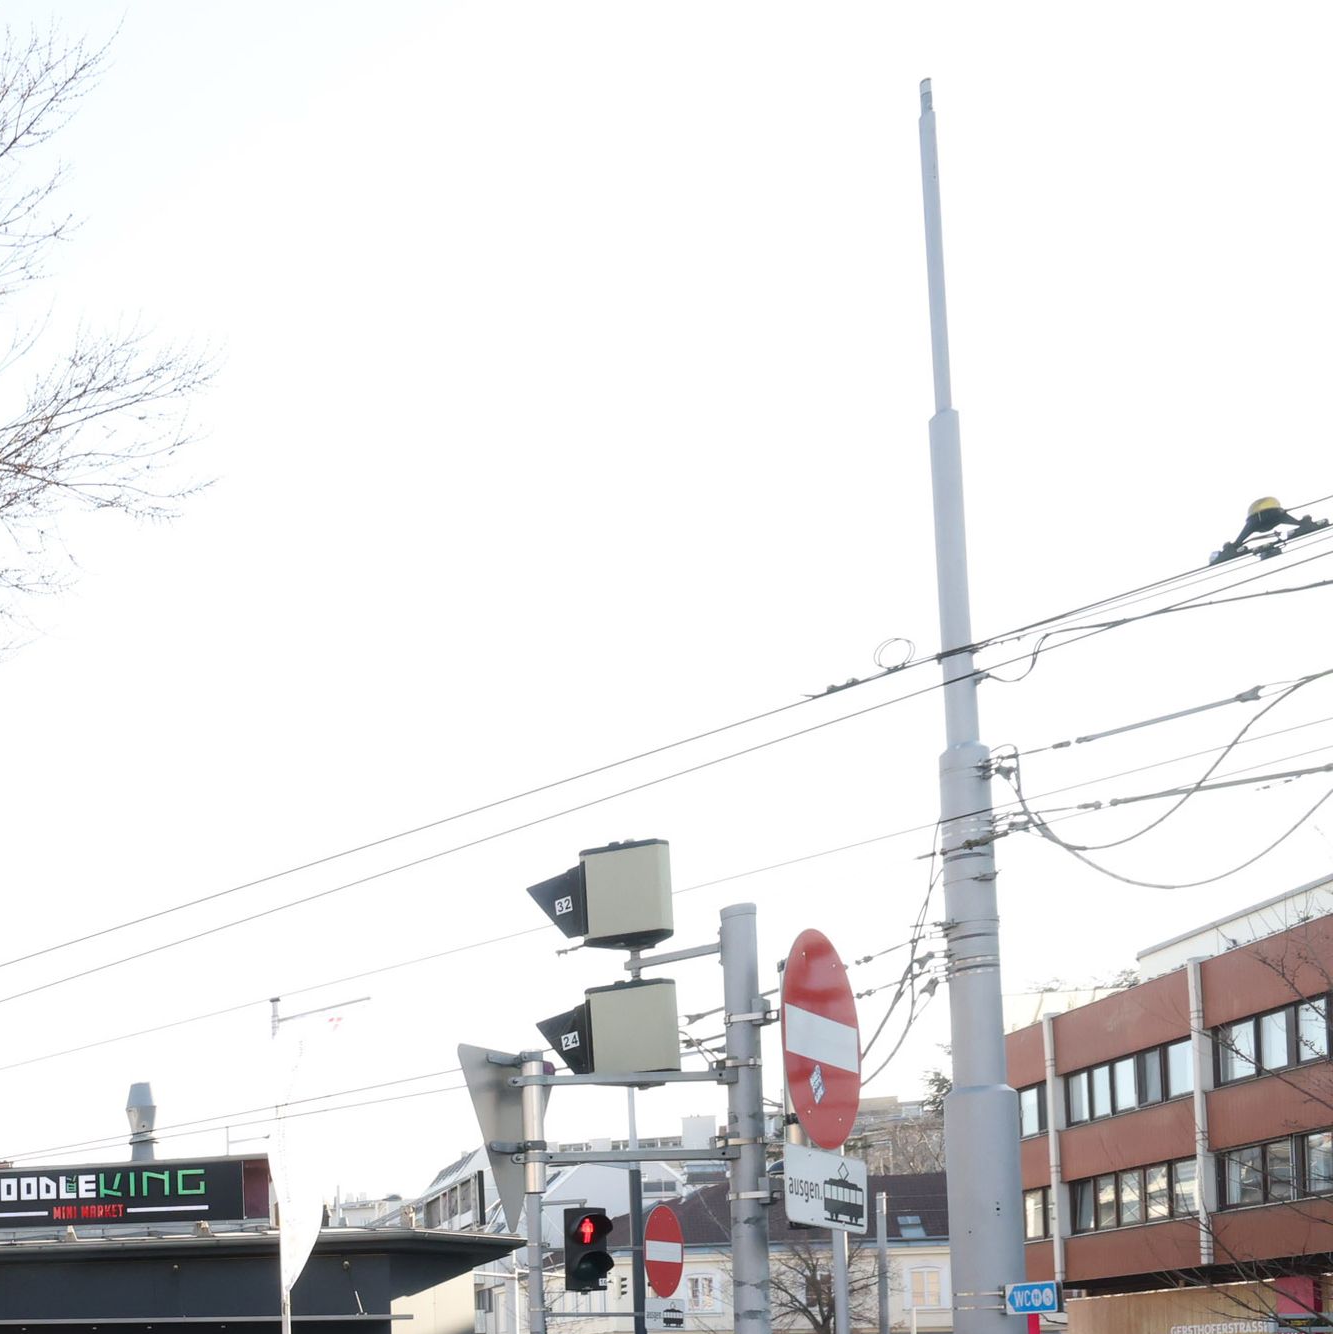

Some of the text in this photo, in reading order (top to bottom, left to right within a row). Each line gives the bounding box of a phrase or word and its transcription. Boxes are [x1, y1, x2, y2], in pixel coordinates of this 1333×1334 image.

[557, 899, 572, 912] 32
[563, 1034, 578, 1047] 24
[789, 1176, 823, 1203] ausgen.
[53, 1204, 124, 1220] MINI MARKET
[1013, 1290, 1031, 1307] WC
